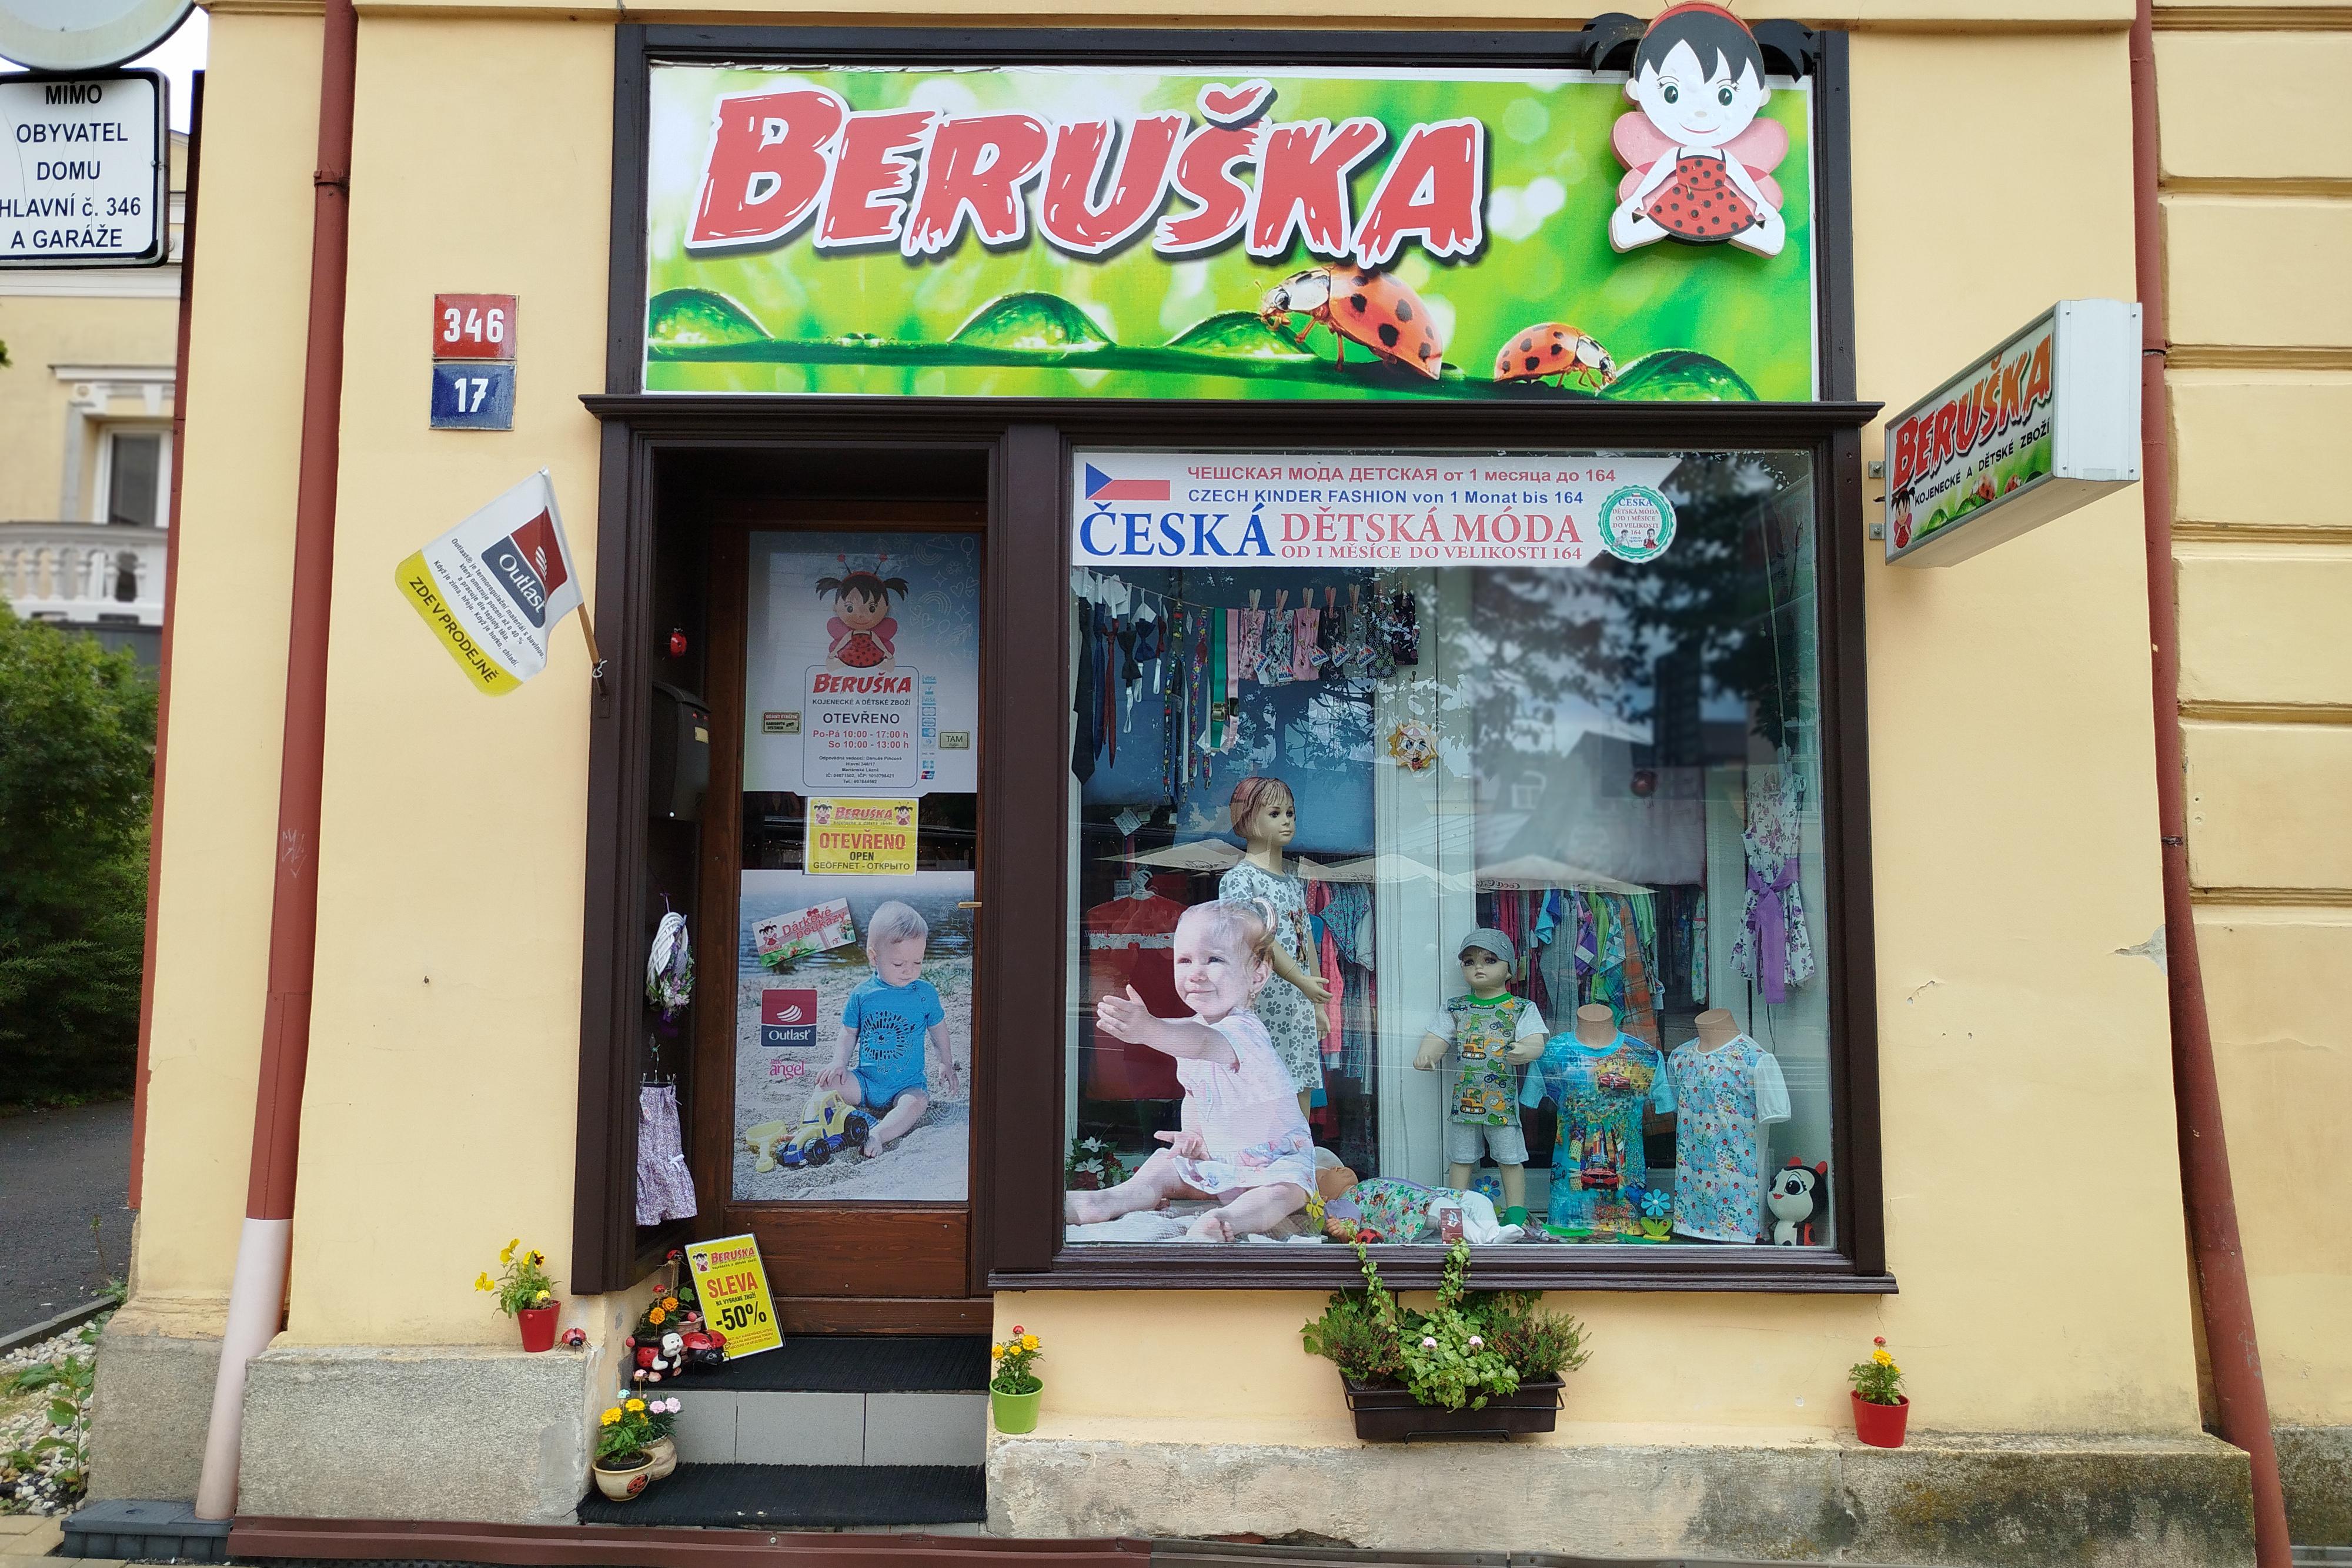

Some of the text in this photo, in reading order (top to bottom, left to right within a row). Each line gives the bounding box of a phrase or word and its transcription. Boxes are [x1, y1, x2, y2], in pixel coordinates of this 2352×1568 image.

[46, 84, 102, 104] MIMO
[16, 122, 128, 143] OBYVATEL
[37, 161, 101, 180] DOMU
[685, 83, 1484, 266] BERUŠKA
[0, 193, 141, 217] HLAVNÍ č. 346
[11, 224, 122, 249] A GARÁŽE
[444, 308, 504, 343] 346
[455, 378, 489, 412] 17
[1892, 333, 2052, 492] BERUŠKA
[1915, 416, 2050, 506] KOJENECKÉ A DĚTSKÉ ZBOŽÍ
[1188, 467, 1616, 483] ЧЕШСКАЯ МОДА ДЕТСКАЯ от 1 месяца до 164
[1188, 489, 1583, 504] CZECH KINDER FASHION von 1 Monat bis 164
[1080, 502, 1583, 557] ČESKÁ DĚTSKÁ MÓDA
[1281, 543, 1582, 560] OD 1 MĚSÍCE DO VELIKOSTI 164
[469, 563, 478, 571] je
[475, 569, 509, 610] termoregulační
[499, 553, 547, 613] Outlast
[433, 560, 447, 575] Když
[443, 573, 452, 581] je
[448, 580, 463, 597] zima,
[460, 594, 476, 613] hřeje.
[473, 611, 487, 626] Když
[483, 624, 492, 633] je
[488, 630, 505, 649] horko,
[459, 563, 473, 579] který
[470, 577, 490, 601] omezuje
[502, 617, 510, 626] až
[510, 629, 519, 638] 40
[516, 636, 525, 645] %
[460, 580, 480, 603] pracuje
[477, 600, 487, 611] dle
[483, 610, 501, 630] teploty
[498, 628, 511, 643] těla.
[409, 576, 499, 684] ZDE V PRODEJNĚ
[813, 672, 911, 694] BERUŠKA
[823, 711, 900, 724] OTEVŘENO
[835, 807, 893, 820] BERUŠKA
[820, 829, 906, 850] OTEVŘENO
[850, 852, 874, 861] OPEN
[782, 906, 831, 937] Dárkové
[770, 1061, 805, 1080] angel
[710, 1247, 754, 1264] BERUŠKA
[707, 1272, 759, 1298] SLEVA
[723, 1295, 743, 1305] VYBRANÉ
[744, 1292, 756, 1300] ZBOŽÍ
[716, 1301, 766, 1330] -50%
